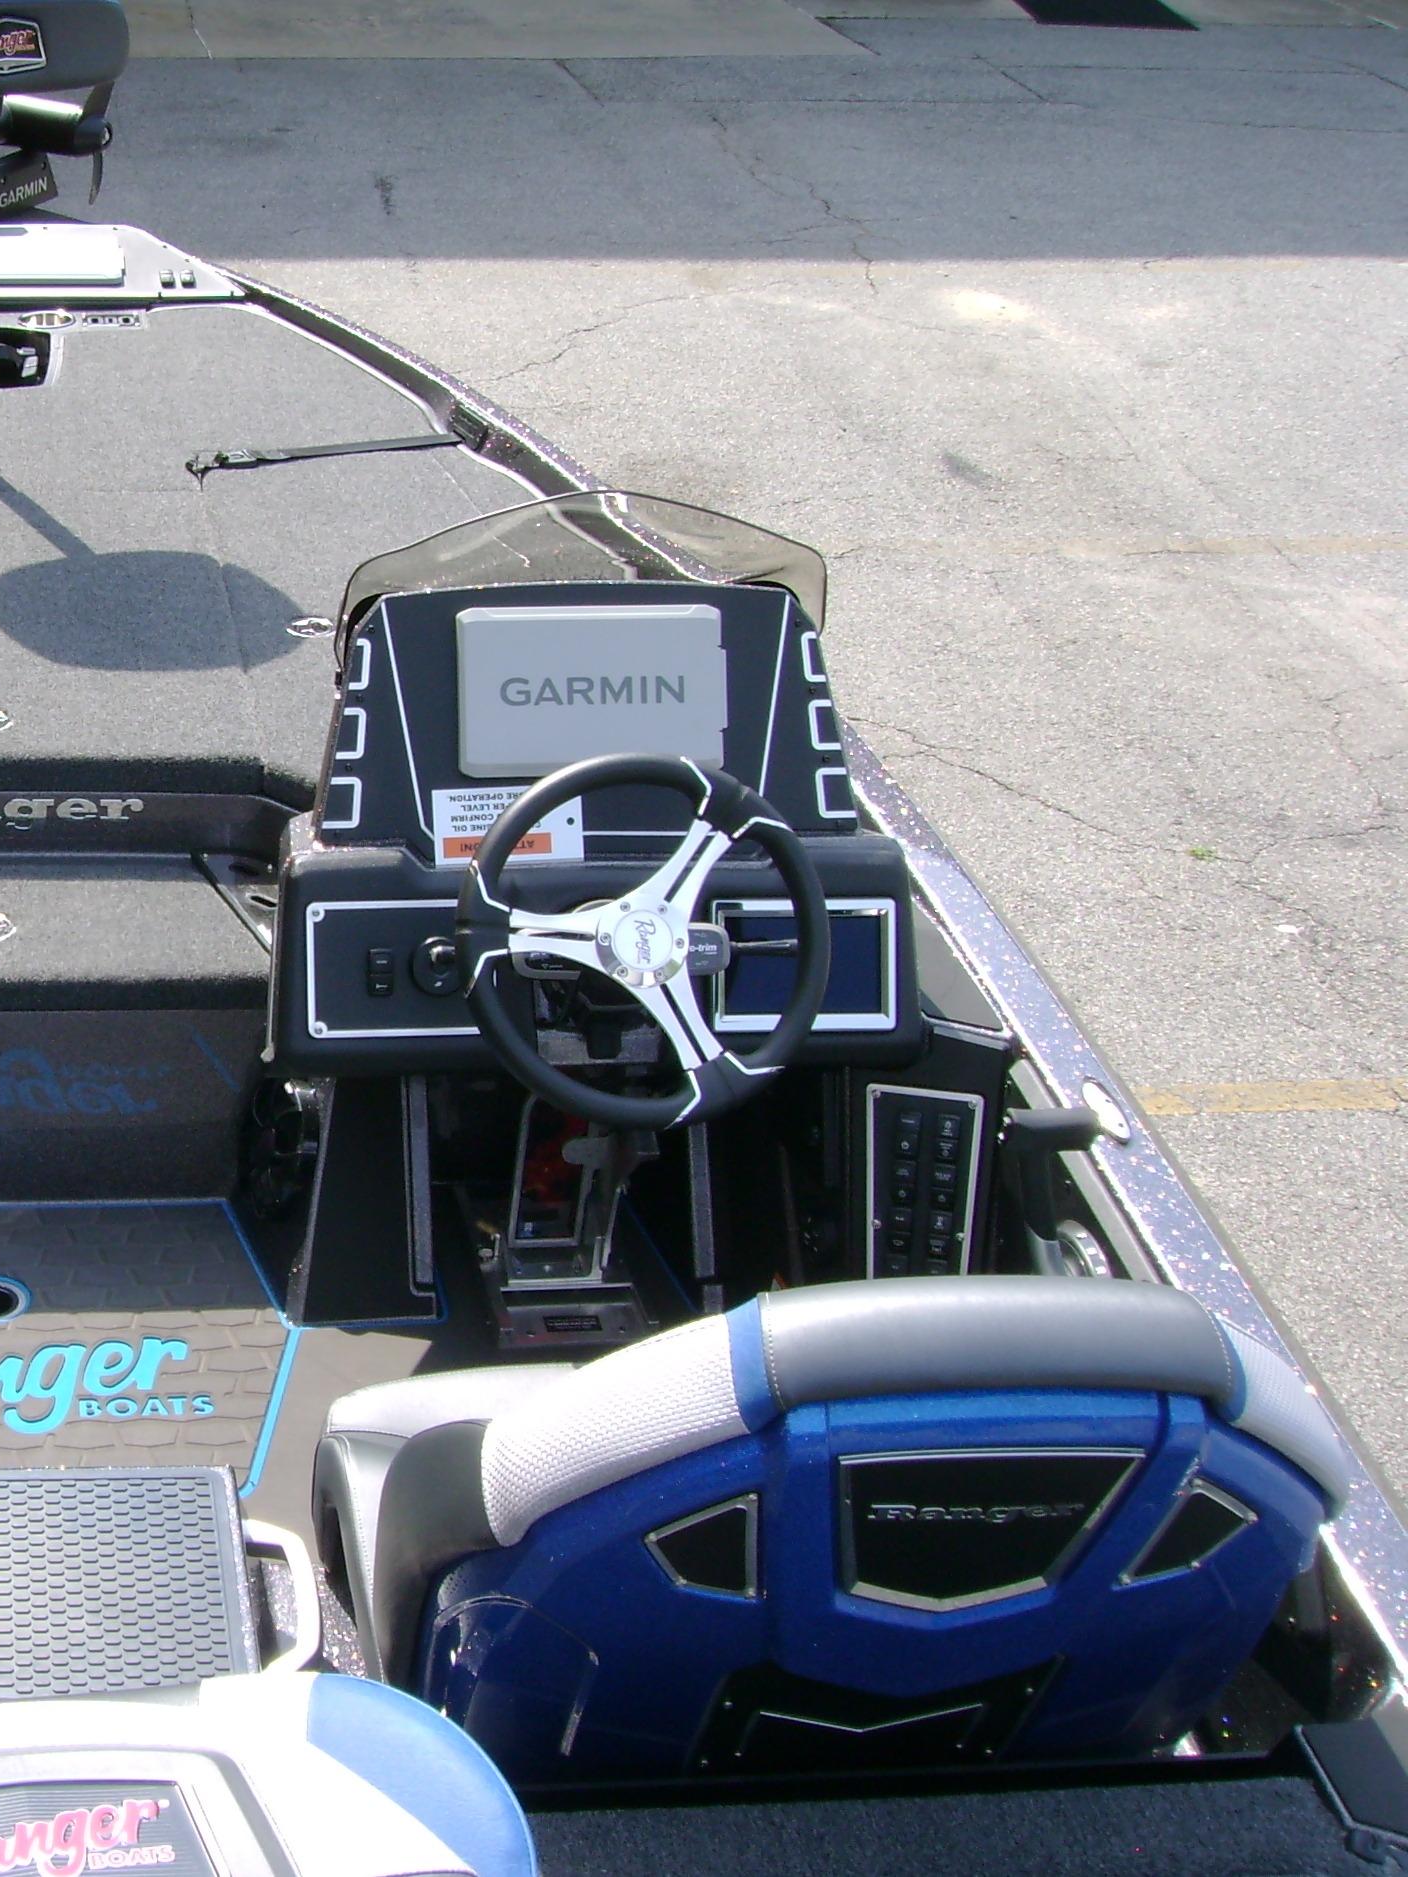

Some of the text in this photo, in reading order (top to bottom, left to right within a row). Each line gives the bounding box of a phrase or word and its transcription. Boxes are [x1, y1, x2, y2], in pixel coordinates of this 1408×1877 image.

[499, 675, 686, 706] GARMIN
[450, 813, 495, 823] CONFIRM
[460, 803, 490, 812] LEVEL
[78, 1395, 215, 1419] BOATS
[868, 1503, 1085, 1523] Ranger
[88, 1844, 176, 1870] BOATS
